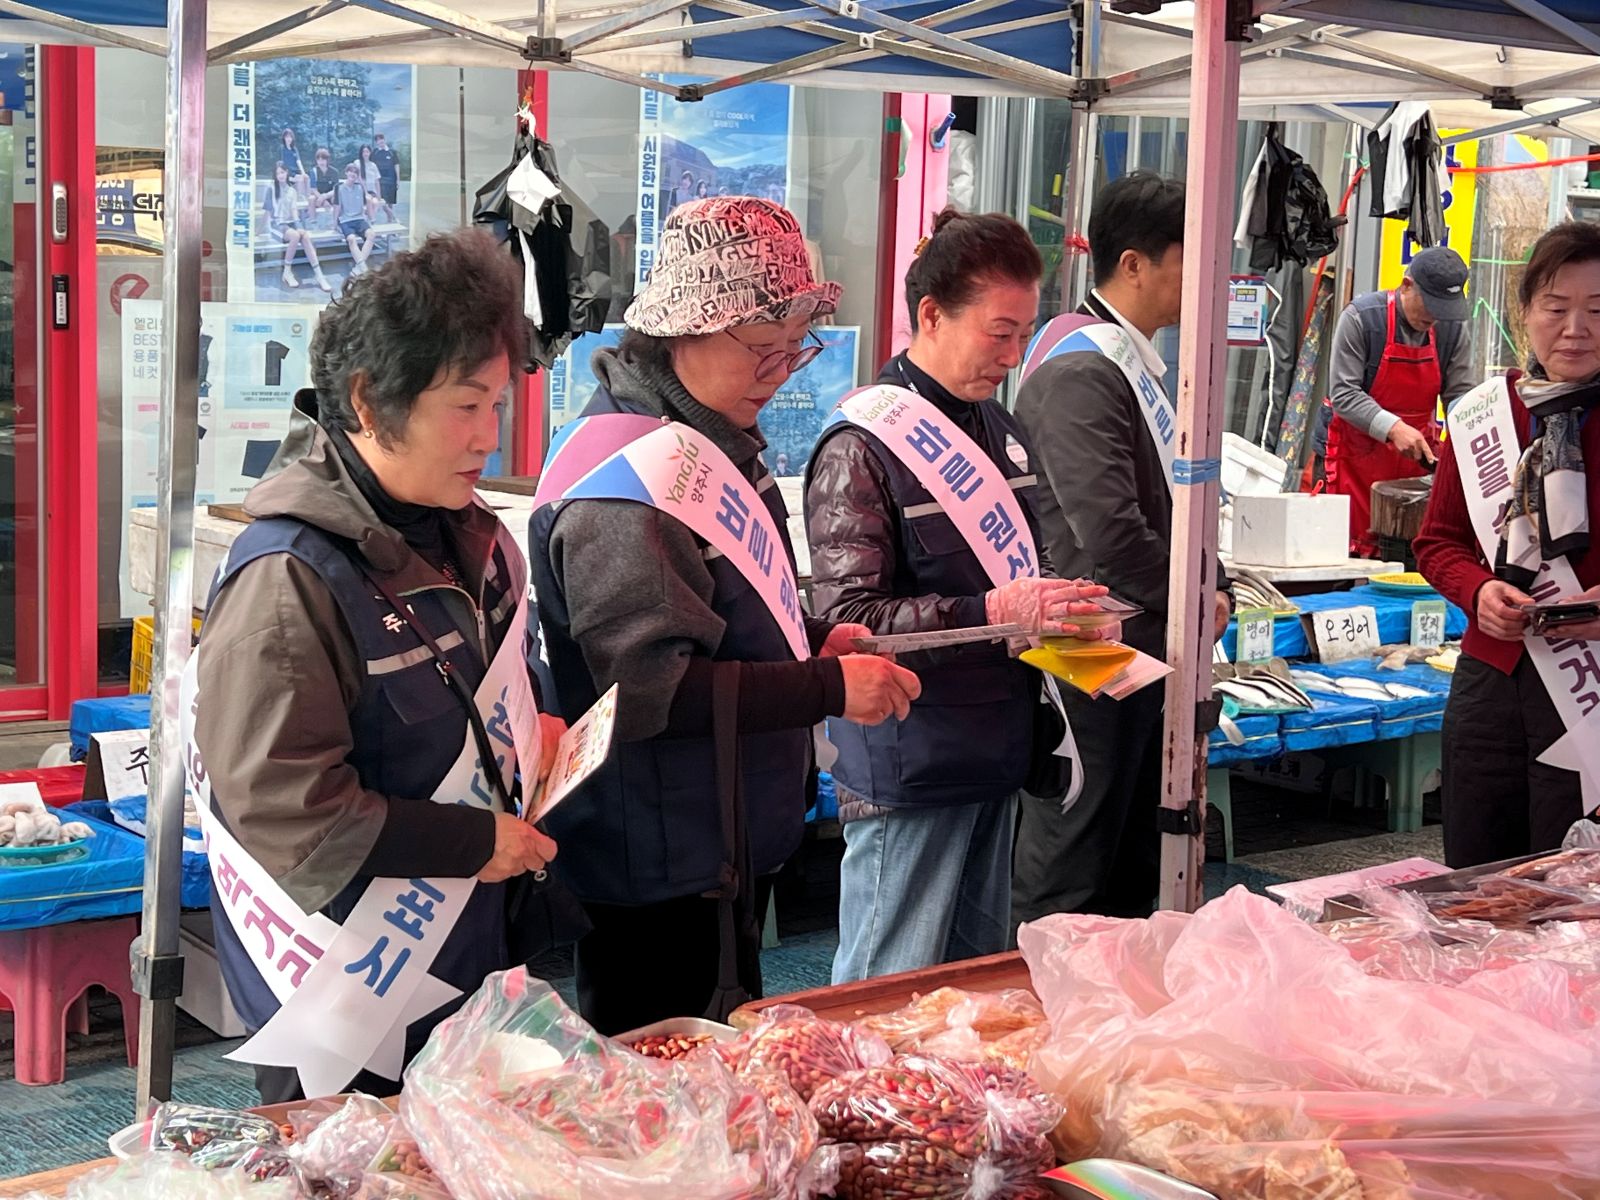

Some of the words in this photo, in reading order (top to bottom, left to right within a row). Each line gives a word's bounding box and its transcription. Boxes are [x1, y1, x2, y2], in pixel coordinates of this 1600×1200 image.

[233, 103, 250, 122] 더
[233, 128, 251, 186] 쾌적한
[642, 136, 657, 188] 시원한
[233, 190, 250, 248] 체육복
[641, 193, 655, 244] 여름을
[132, 366, 159, 379] 네컷
[133, 349, 160, 363] 용품
[862, 389, 900, 424] Yangju
[882, 402, 910, 426] 양주시
[1137, 370, 1174, 446] 바른
[1454, 391, 1499, 424] Yangju
[1465, 408, 1495, 431] 양주시
[665, 440, 699, 505] Yangju
[690, 462, 713, 504] 양주시
[905, 418, 984, 502] 바른
[1470, 426, 1511, 499] 믿음을
[715, 482, 775, 579] 바른
[1325, 613, 1371, 642] 오징어
